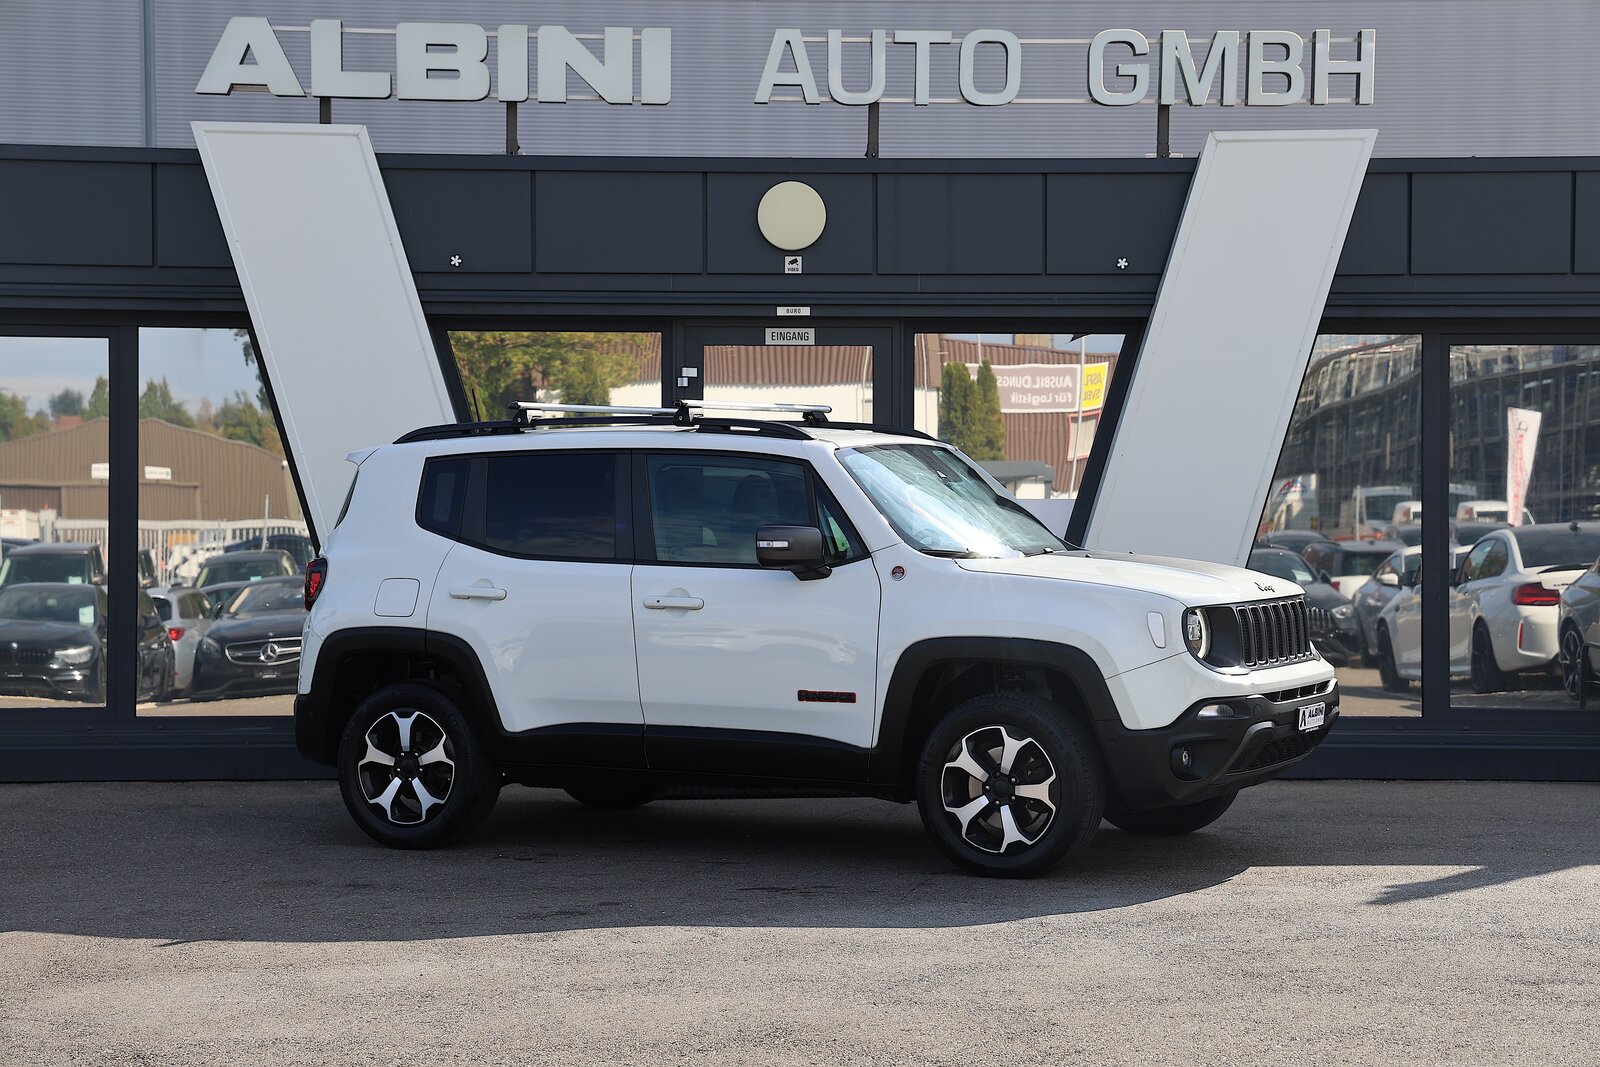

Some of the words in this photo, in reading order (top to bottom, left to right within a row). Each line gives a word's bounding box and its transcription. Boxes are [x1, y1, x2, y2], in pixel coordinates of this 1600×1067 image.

[195, 16, 672, 105] ALBINI
[754, 28, 1022, 107] AUTO
[1088, 28, 1377, 107] GMBH
[771, 331, 809, 341] EINGANG
